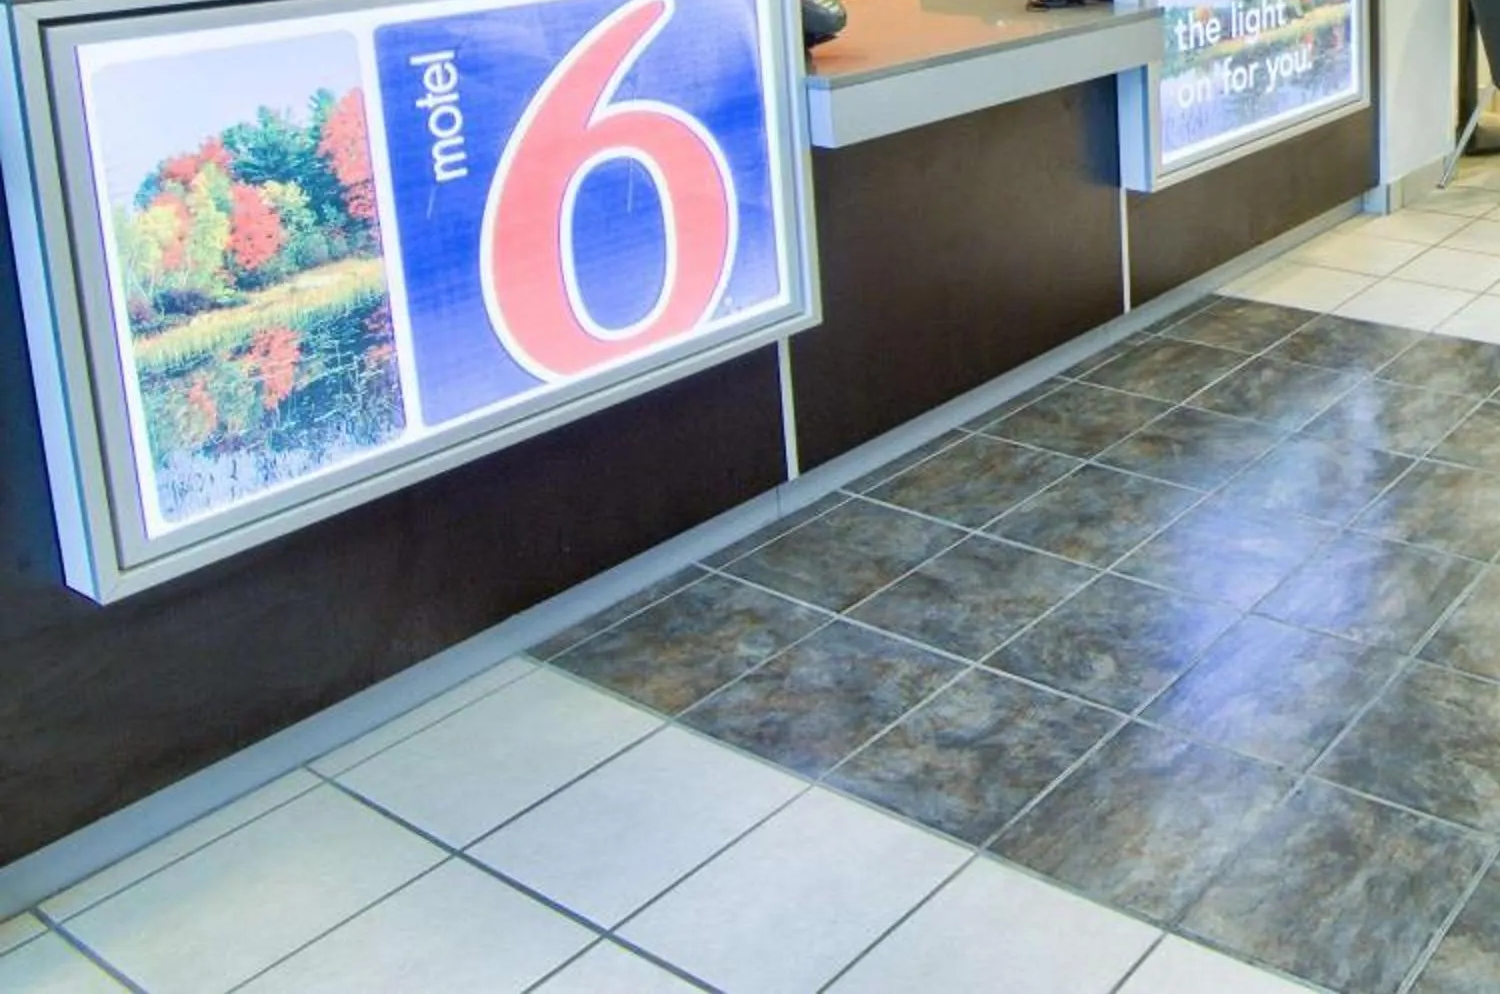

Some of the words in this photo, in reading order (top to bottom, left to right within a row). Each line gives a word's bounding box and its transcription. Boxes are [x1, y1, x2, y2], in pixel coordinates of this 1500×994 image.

[1174, 8, 1221, 51] the
[1177, 73, 1211, 109] on
[1223, 56, 1259, 95] for
[410, 49, 468, 183] motel
